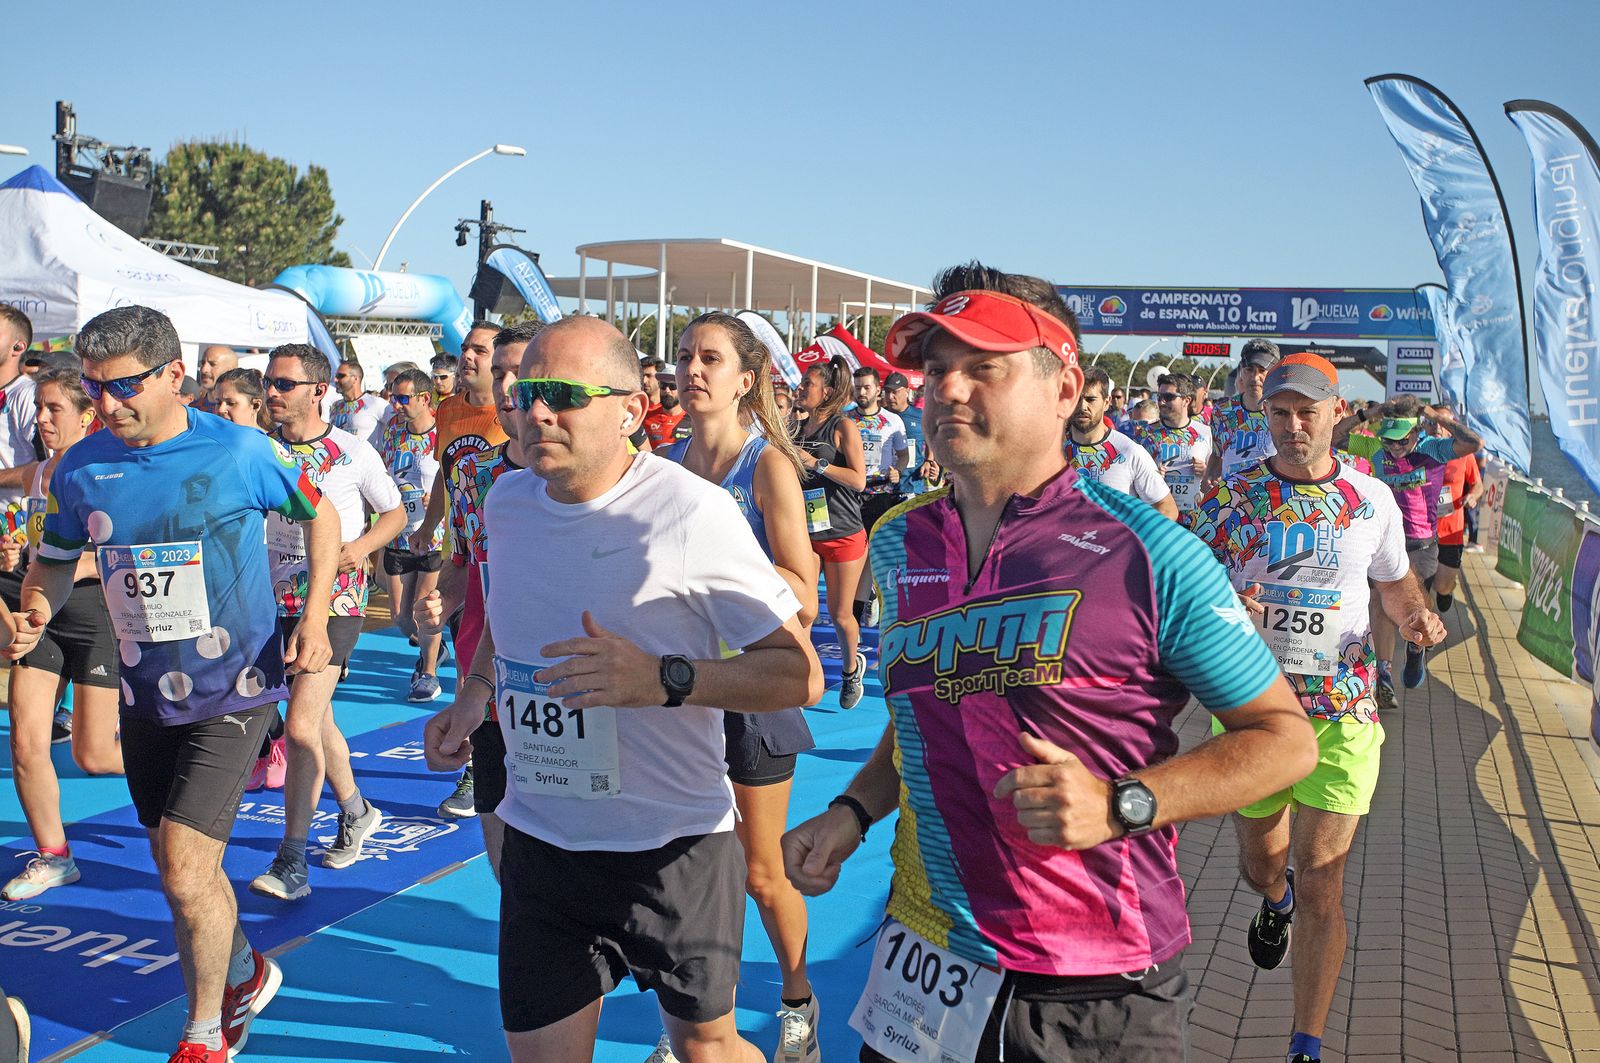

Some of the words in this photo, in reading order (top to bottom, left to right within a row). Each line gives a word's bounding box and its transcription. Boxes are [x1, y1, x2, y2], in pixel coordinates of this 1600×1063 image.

[1142, 292, 1242, 306] CAMPEONATO
[1140, 308, 1156, 319] de
[1159, 306, 1209, 320] ESPAÑA
[1217, 307, 1241, 323] 10
[1246, 305, 1278, 323] km
[1316, 304, 1360, 318] HUELVA
[1188, 322, 1203, 330] ruta
[1206, 322, 1240, 331] Absoluto
[1249, 322, 1276, 331] Master
[161, 550, 191, 562] 2023
[1316, 552, 1339, 568] VA
[124, 570, 175, 599] 937
[1264, 589, 1285, 598] HUELVA
[140, 603, 163, 611] EMILIO
[1262, 606, 1325, 636] 1258
[145, 624, 173, 634] Syrluz
[1273, 636, 1303, 645] RICARDO
[1278, 655, 1303, 666] Syrluz
[506, 670, 530, 683] HUELVA
[505, 695, 585, 740] 1481
[522, 741, 566, 755] SANTIAGO
[514, 751, 539, 763] PEREZ
[541, 757, 579, 768] AMADOR
[535, 771, 569, 786] Syrluz
[884, 931, 969, 1008] 1003
[883, 1025, 921, 1055] Syrluz
